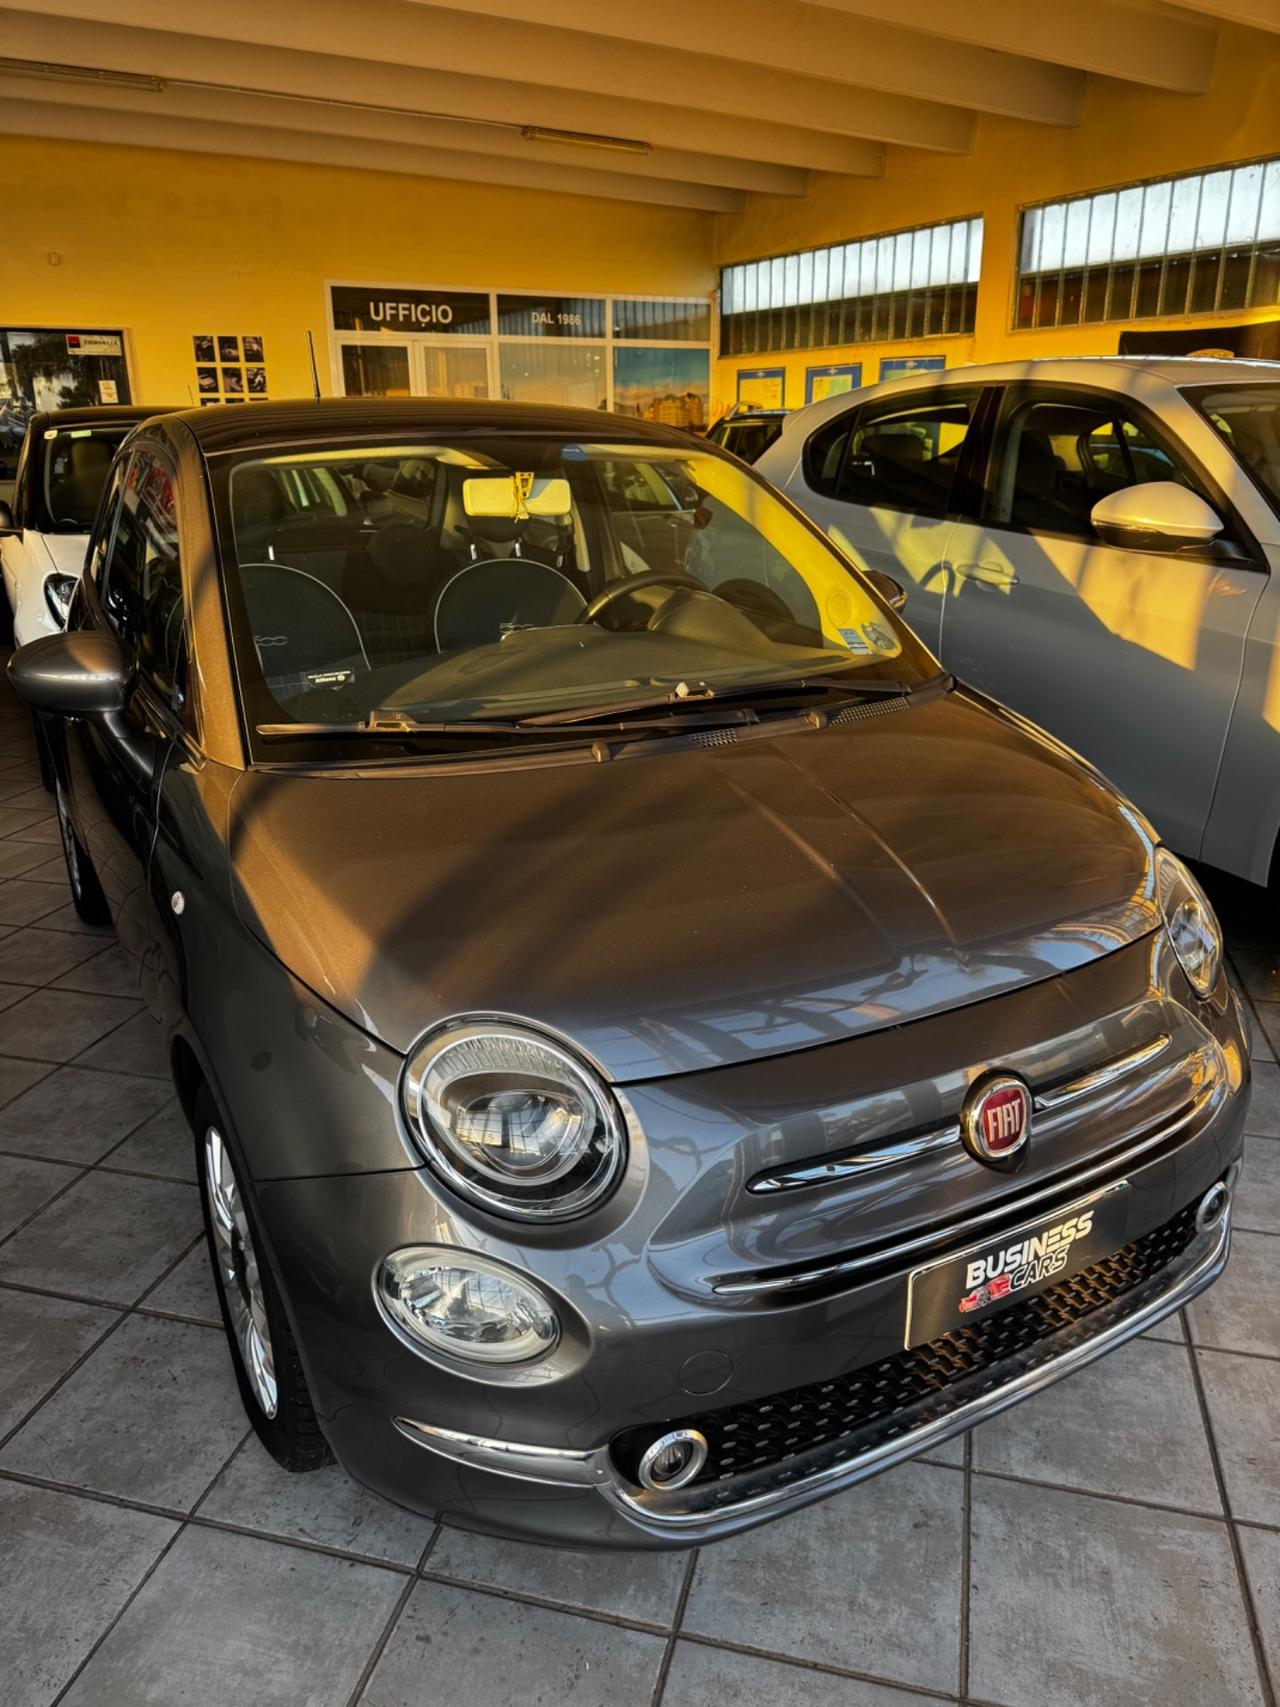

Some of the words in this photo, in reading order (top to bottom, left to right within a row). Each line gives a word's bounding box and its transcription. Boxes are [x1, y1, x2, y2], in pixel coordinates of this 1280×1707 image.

[370, 302, 453, 324] UFFICIO
[531, 312, 555, 325] DAL
[557, 314, 582, 326] 1986
[987, 1098, 1022, 1142] FIAT
[966, 1210, 1094, 1290] BUSINESS
[1009, 1244, 1070, 1293] CARS
